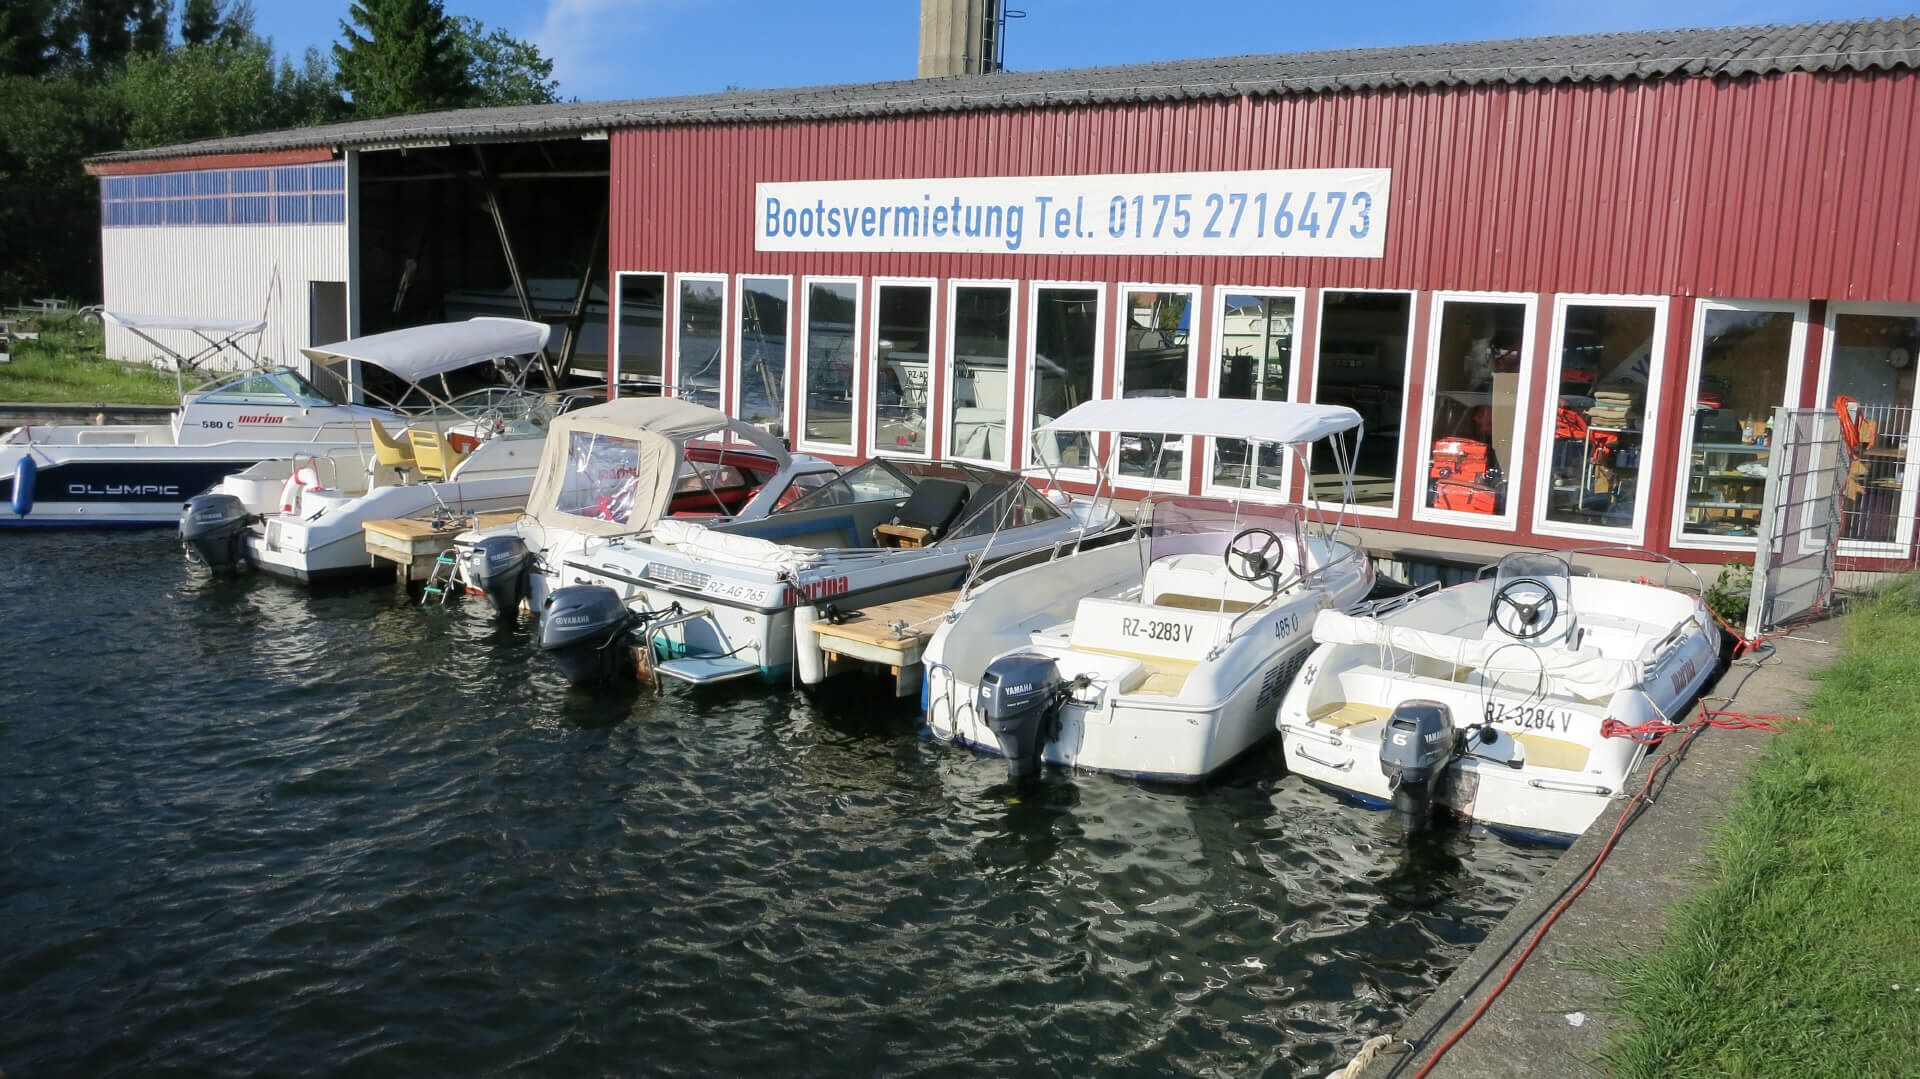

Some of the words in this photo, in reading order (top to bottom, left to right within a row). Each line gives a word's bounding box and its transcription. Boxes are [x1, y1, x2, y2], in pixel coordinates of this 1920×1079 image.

[765, 194, 1024, 250] Bootsvermietung
[1035, 196, 1093, 238] Tel.
[1108, 194, 1192, 238] 0175
[1203, 191, 1372, 239] 2716473
[202, 421, 223, 429] 580
[227, 421, 234, 429] C
[239, 413, 284, 424] marina
[69, 484, 179, 495] OLYMPIC
[707, 581, 743, 598] RZ-AG
[745, 588, 764, 601] 765
[563, 615, 590, 625] YAMAHA
[1122, 617, 1180, 642] RZ-3283
[1184, 624, 1193, 643] V
[1275, 617, 1291, 640] 485
[982, 686, 992, 698] 6
[1005, 682, 1033, 696] YAMAHA
[1485, 702, 1555, 731] RZ-3284
[1562, 711, 1572, 733] V
[1392, 733, 1407, 746] 6
